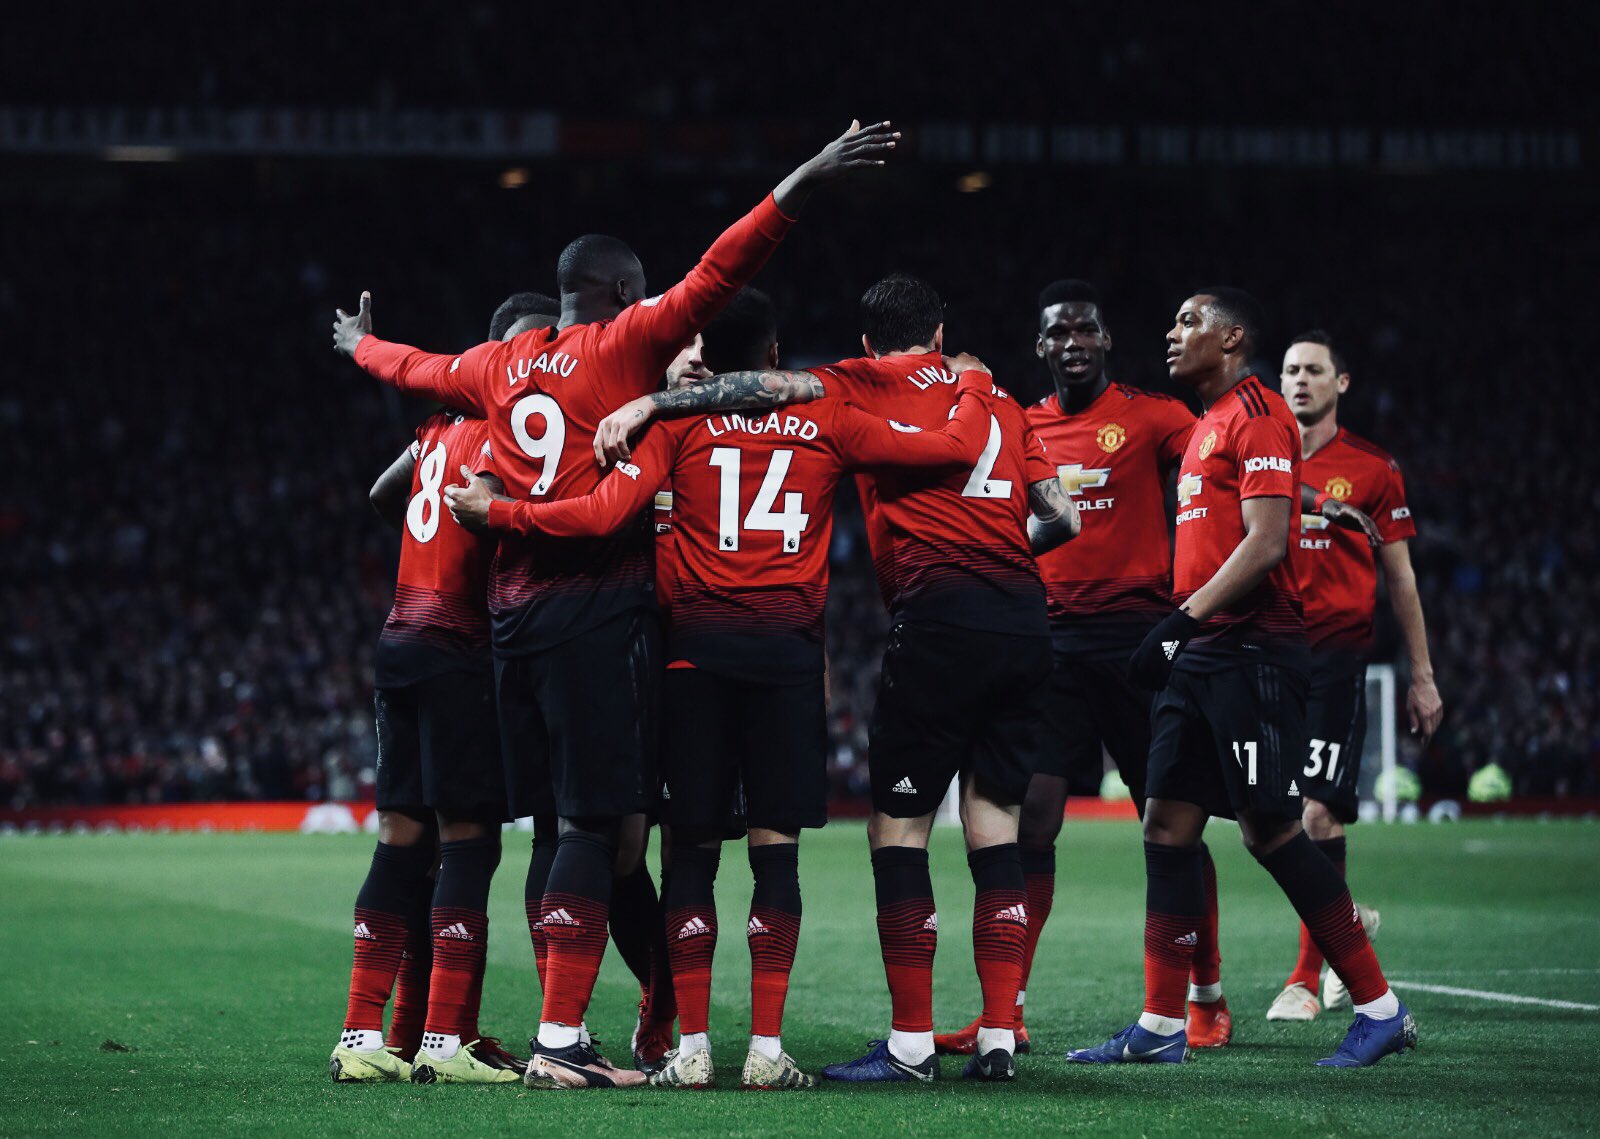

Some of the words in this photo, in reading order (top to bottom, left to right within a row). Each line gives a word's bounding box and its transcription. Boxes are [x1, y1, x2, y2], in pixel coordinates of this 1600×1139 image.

[706, 412, 819, 441] LINGARD
[510, 393, 566, 496] 9
[1244, 456, 1292, 473] KOHLER
[406, 440, 447, 543] 8
[709, 447, 810, 553] 14
[1074, 498, 1114, 511] OLET
[1300, 539, 1331, 549] OLET
[1303, 738, 1341, 781] 31
[543, 917, 580, 925] adidas
[996, 911, 1028, 926] adidas
[440, 931, 474, 941] adidas
[679, 926, 711, 939] adidas
